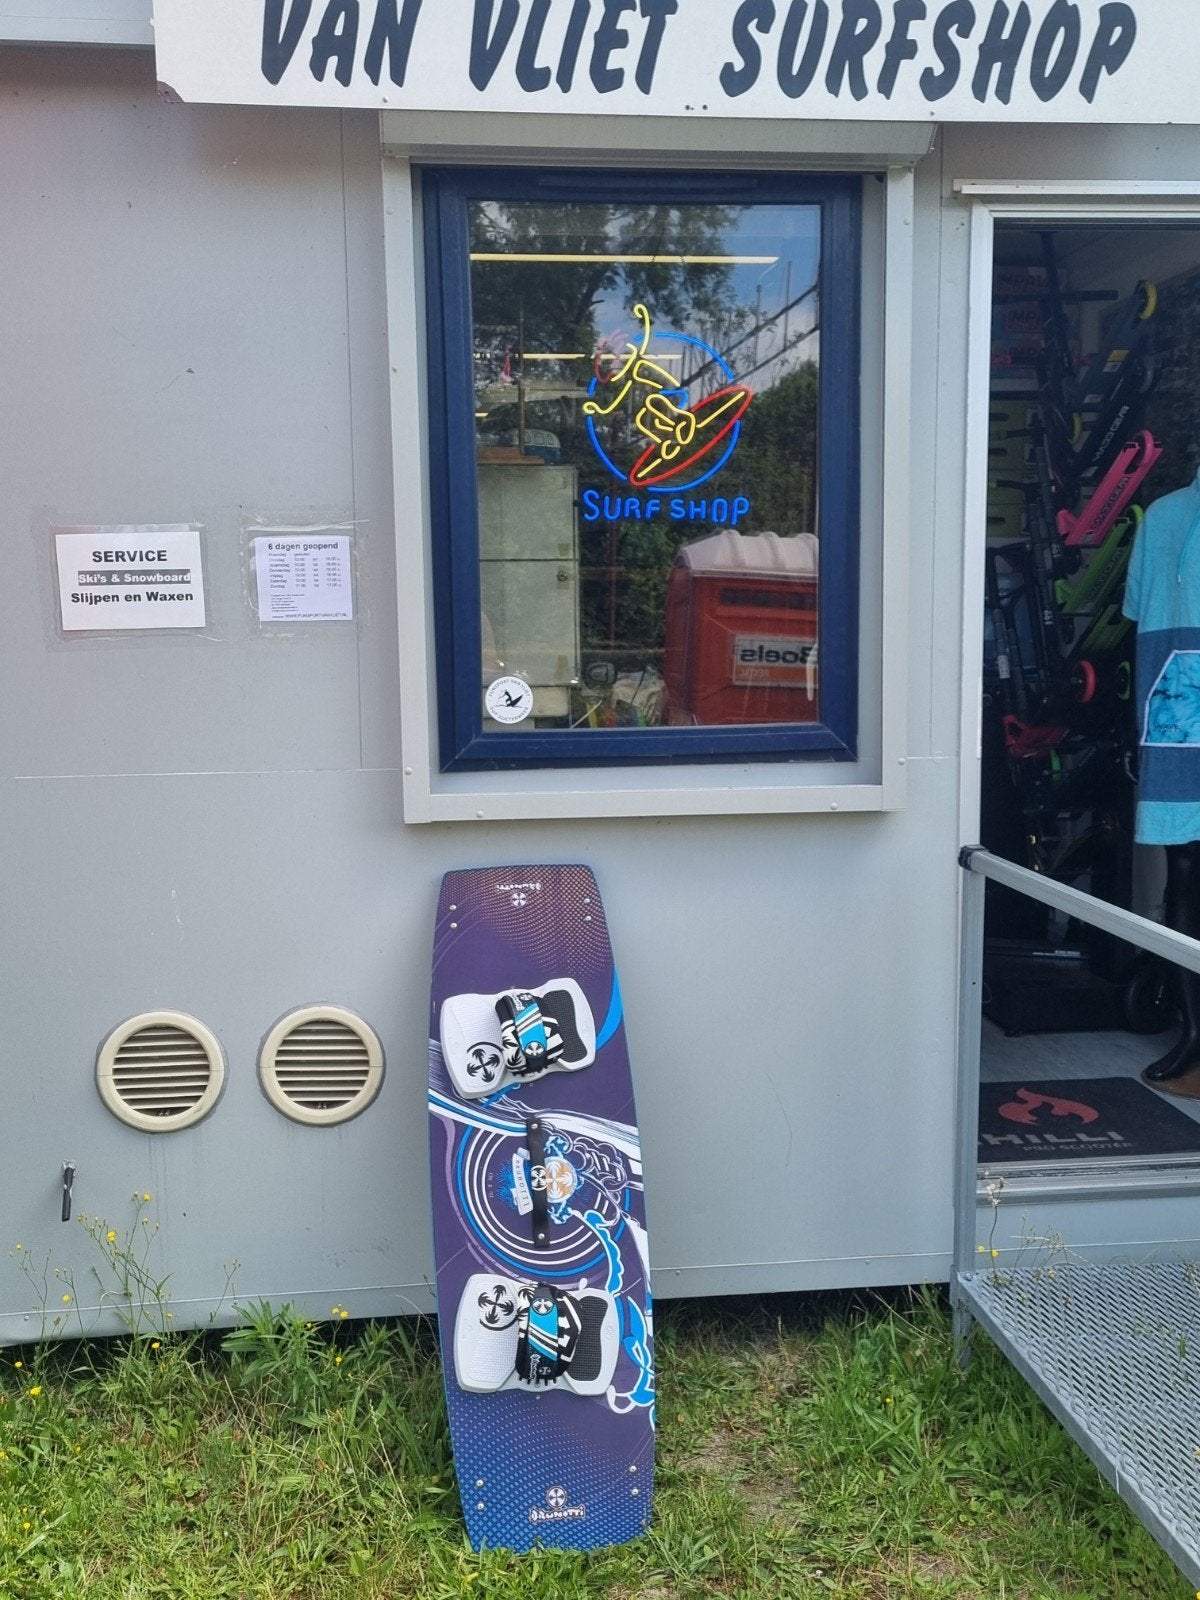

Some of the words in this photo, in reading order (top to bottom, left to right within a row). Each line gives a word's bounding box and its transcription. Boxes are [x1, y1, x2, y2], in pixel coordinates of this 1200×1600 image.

[261, 0, 423, 88] VAN
[469, 0, 679, 95] VLIET
[719, 0, 1137, 104] SURFSHOP
[583, 490, 661, 521] SURF
[670, 496, 750, 526] SHOP
[275, 543, 300, 551] dagen
[303, 542, 339, 551] geopend
[92, 550, 168, 563] SERVICE
[78, 571, 108, 584] Ski's
[111, 571, 120, 583] &
[123, 571, 191, 583] Snowboard
[71, 592, 121, 605] Slijpen
[124, 593, 142, 602] en
[146, 591, 194, 602] Waxen
[978, 1131, 1125, 1145] HILLI
[1024, 1144, 1056, 1152] PRO
[1058, 1142, 1134, 1151] SCOOTER
